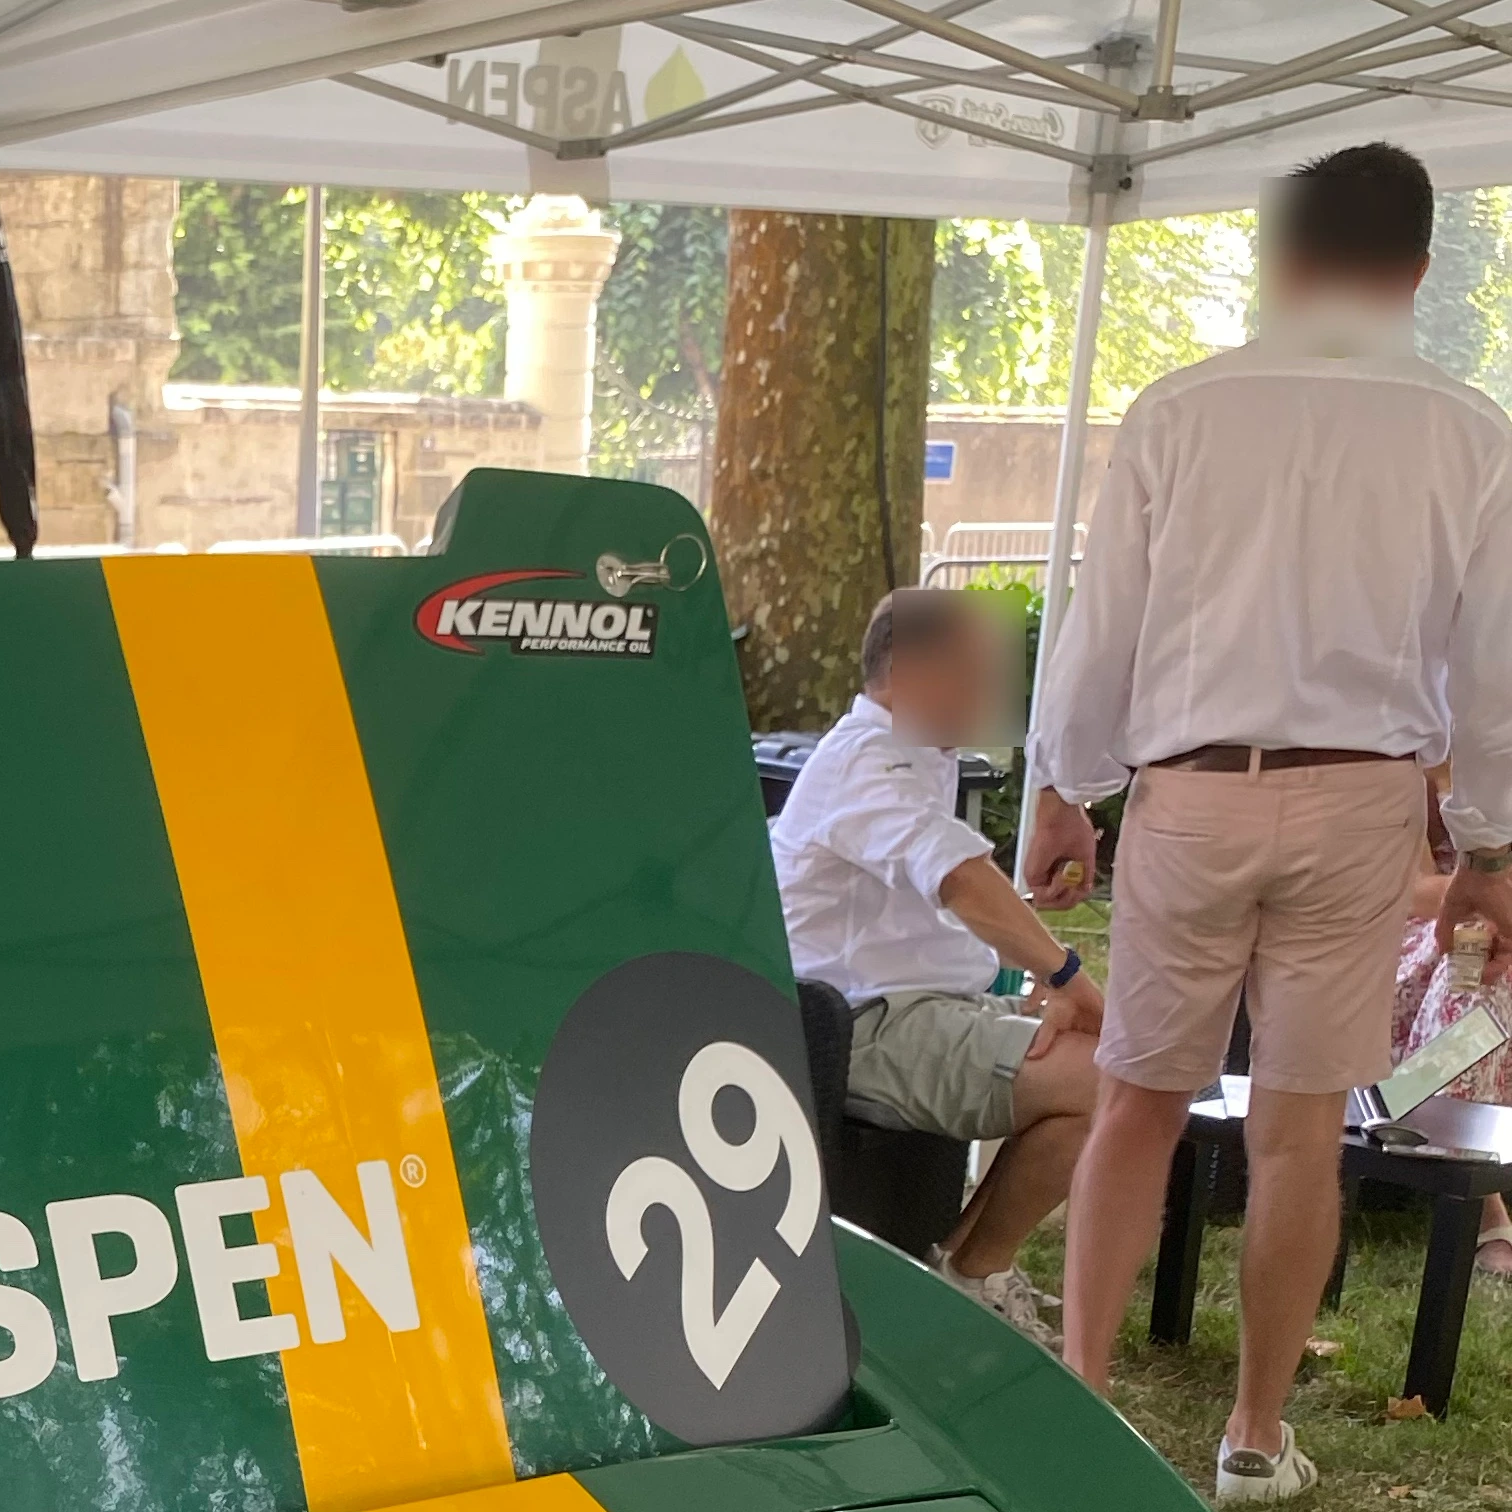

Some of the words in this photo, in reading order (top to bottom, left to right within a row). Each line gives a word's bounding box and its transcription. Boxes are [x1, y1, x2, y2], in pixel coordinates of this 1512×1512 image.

[435, 599, 652, 641] KENNOL
[520, 638, 626, 654] PERFORMANCE
[629, 641, 652, 655] OIL
[605, 1041, 822, 1391] 29
[1229, 1459, 1262, 1470] VEJA
